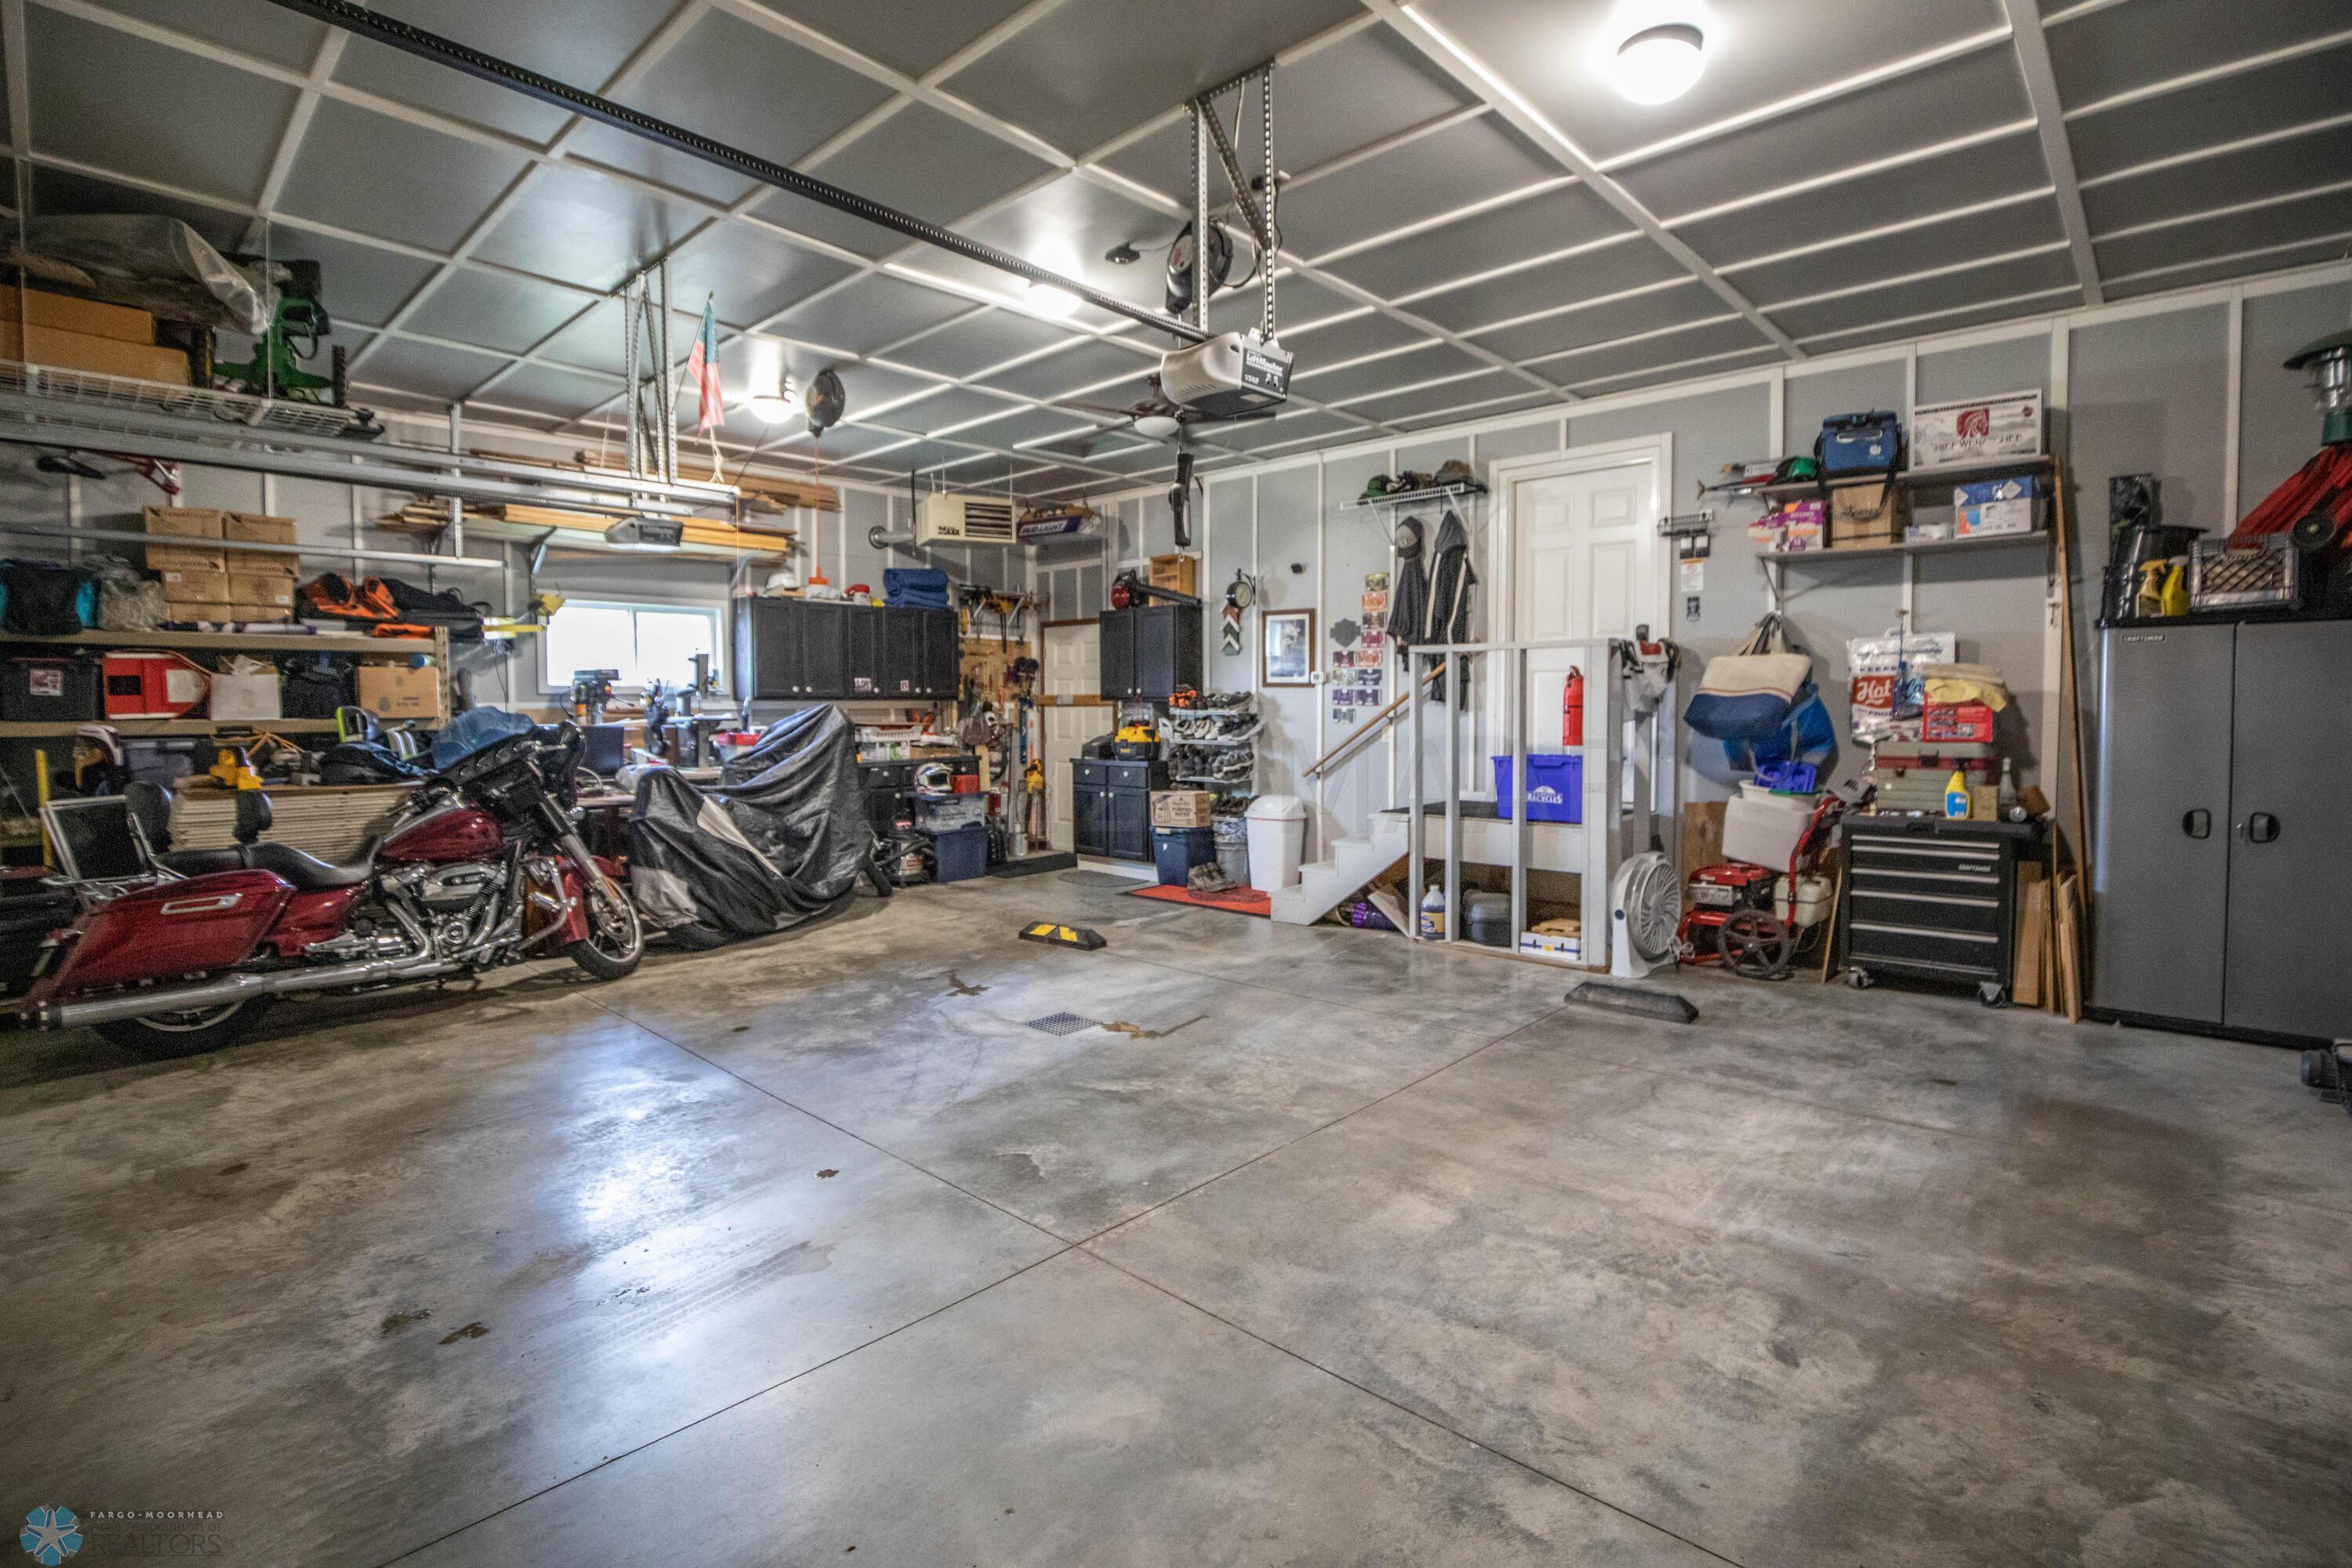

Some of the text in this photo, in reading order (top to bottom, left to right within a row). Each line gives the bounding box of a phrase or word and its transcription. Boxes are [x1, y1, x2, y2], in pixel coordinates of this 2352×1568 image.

[1247, 352, 1283, 372] LiftMaster
[1039, 521, 1065, 532] LIGHT
[1857, 680, 1892, 704] Hot
[1526, 793, 1562, 804] RECYCLES
